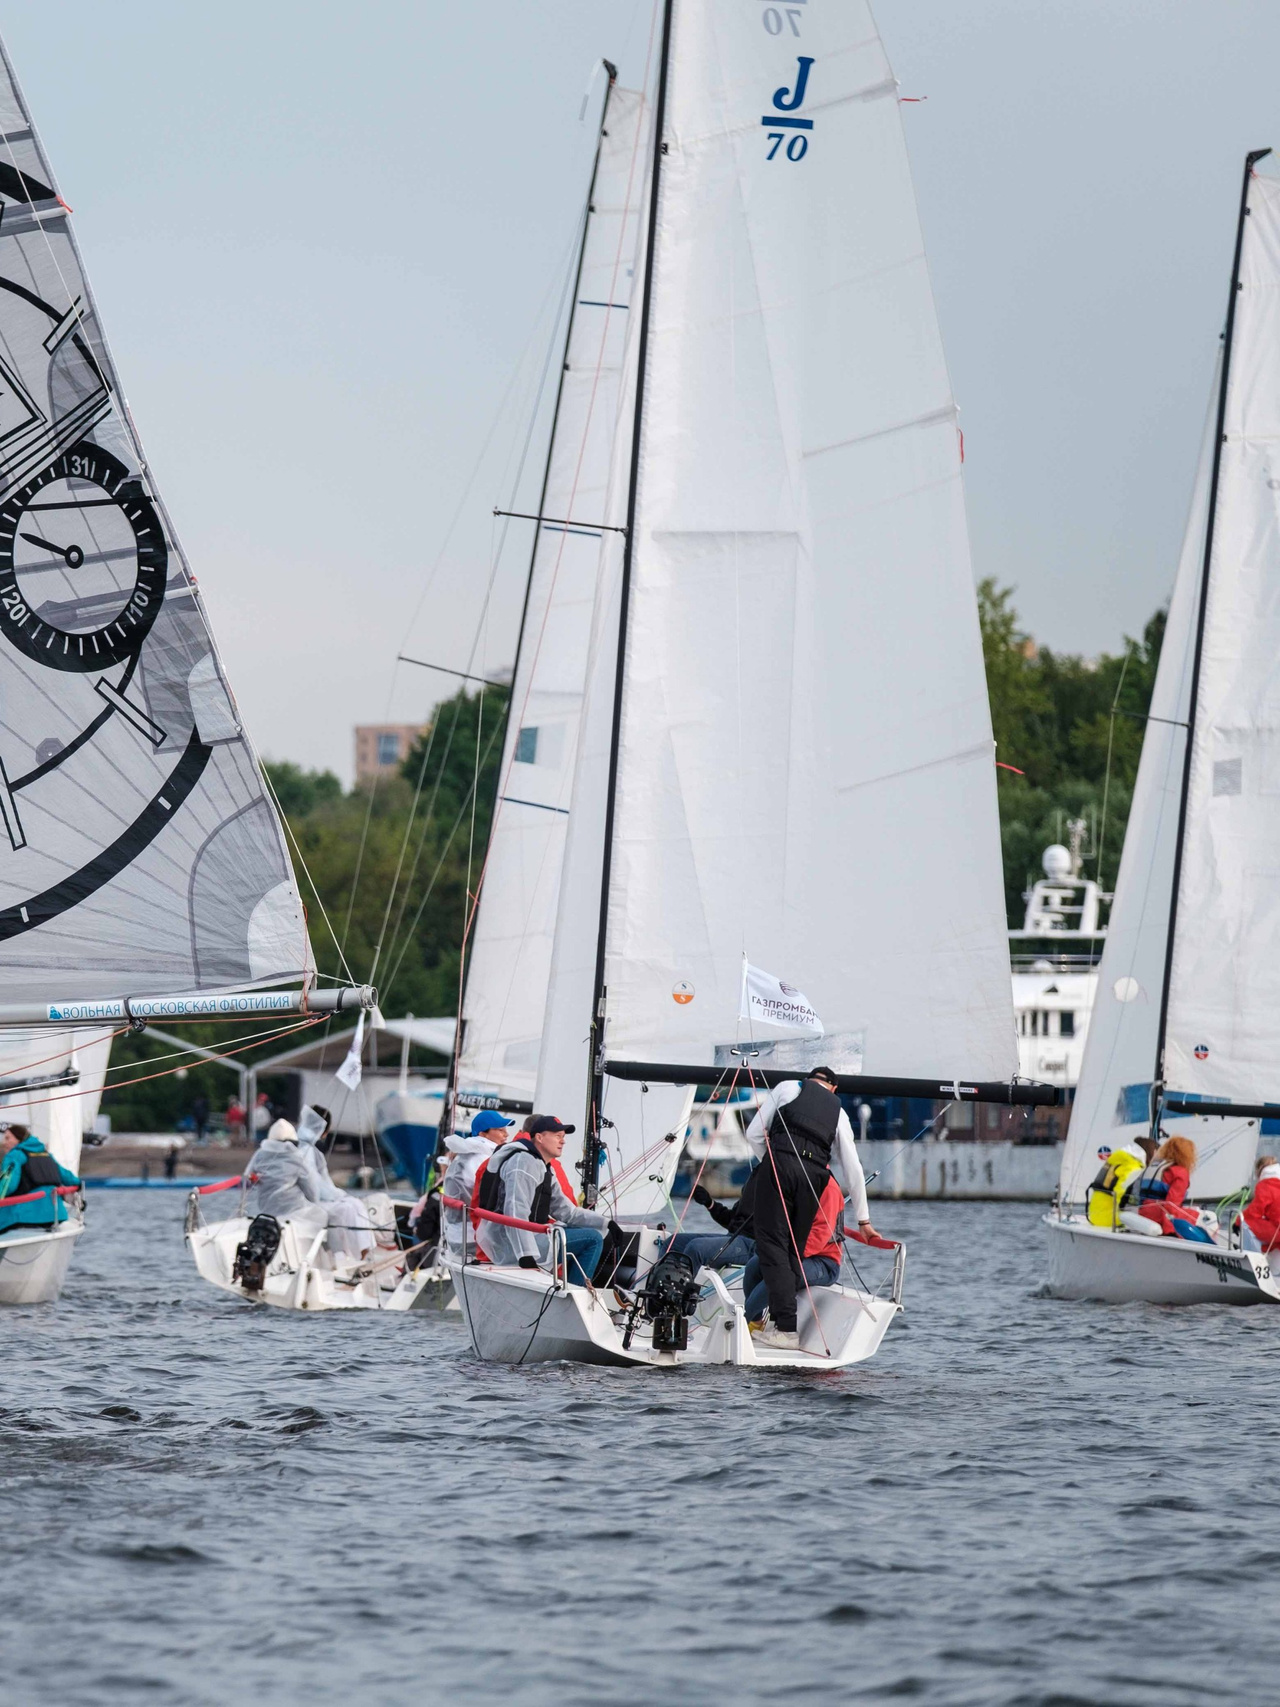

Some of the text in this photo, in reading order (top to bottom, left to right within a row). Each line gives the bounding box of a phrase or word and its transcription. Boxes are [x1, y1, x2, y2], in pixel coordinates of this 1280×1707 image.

[772, 56, 815, 111] J
[766, 132, 808, 162] 70
[71, 455, 89, 476] 31
[1, 591, 27, 621] 20
[129, 595, 149, 618] 10
[63, 995, 290, 1019] ВОЛЬНАЯ МОСКОВСКАЯ ФЛОТИЛИЯ
[762, 1008, 815, 1024] ПРЕМИУМ
[1255, 1265, 1271, 1279] 33
